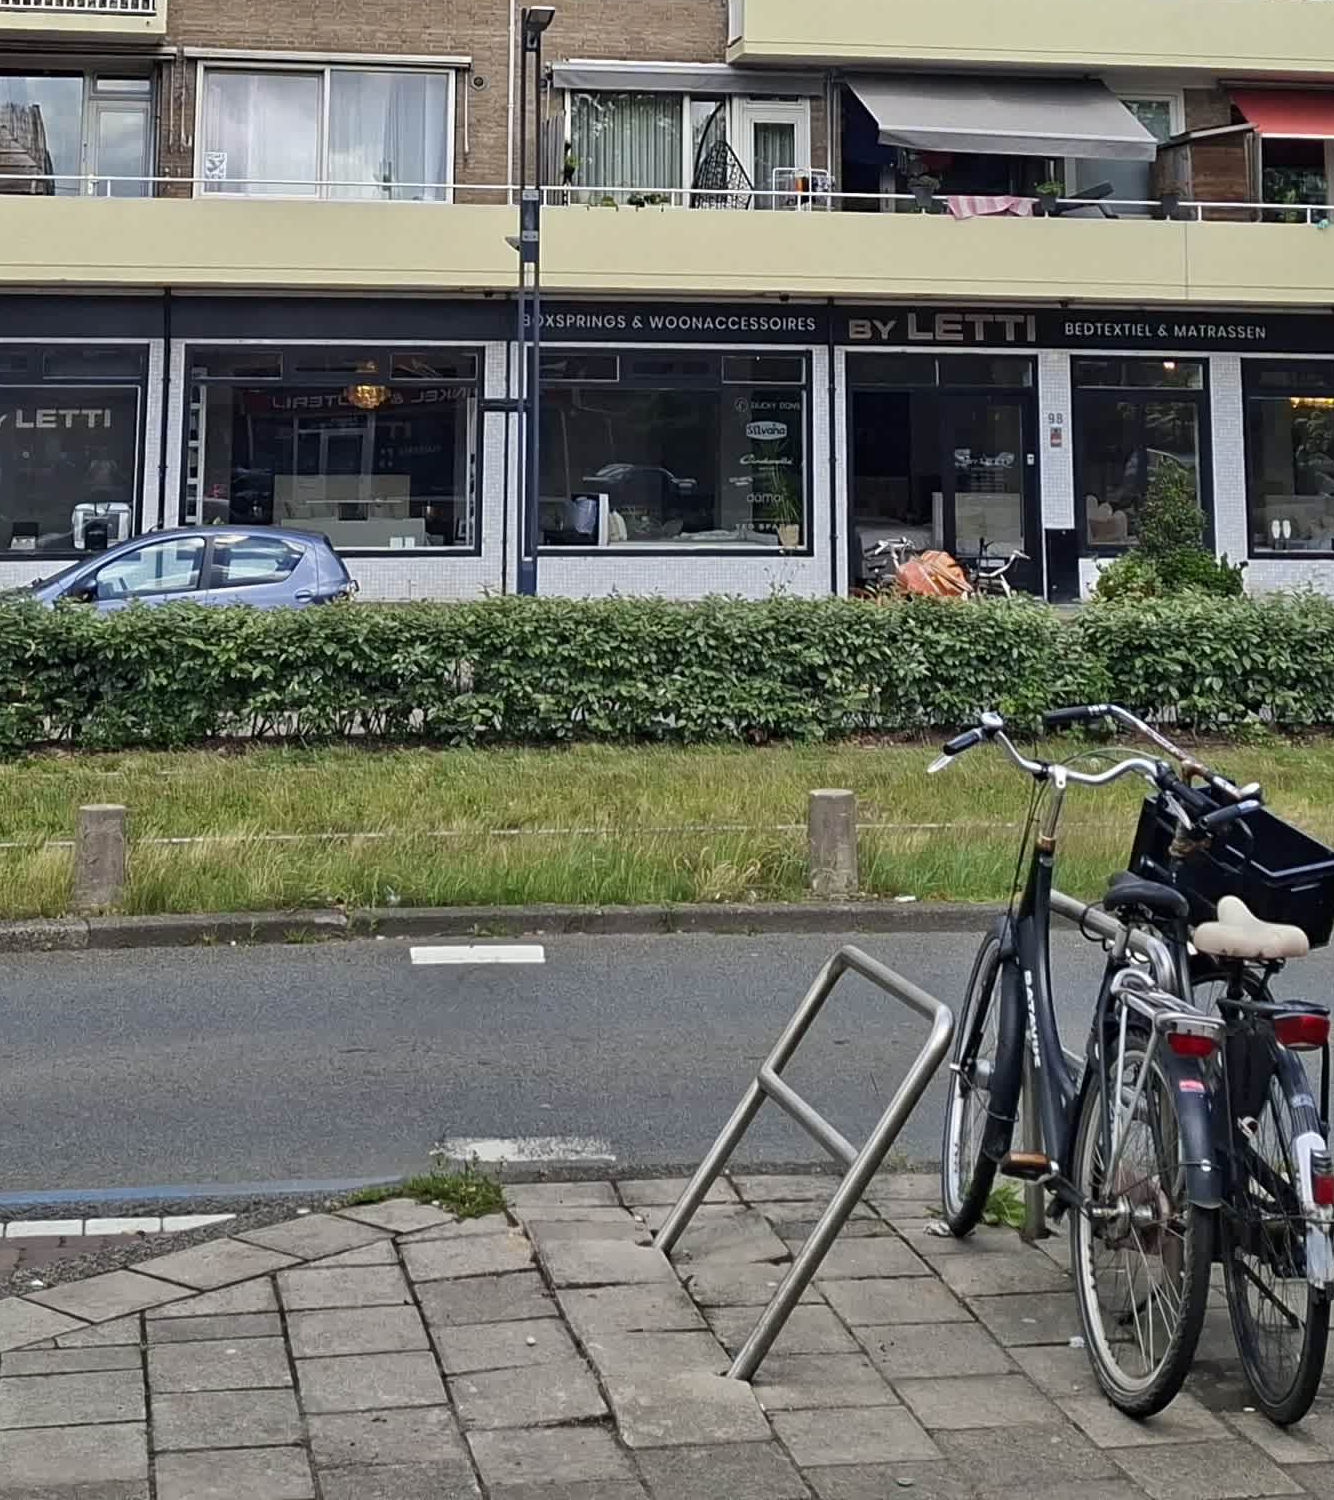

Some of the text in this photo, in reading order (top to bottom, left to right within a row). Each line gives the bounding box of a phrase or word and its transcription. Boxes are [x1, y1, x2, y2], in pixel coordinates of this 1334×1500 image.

[631, 315, 644, 329] &
[649, 315, 817, 331] WOONACCESSOIRES
[848, 312, 1036, 342] BY LETTI
[1064, 322, 1267, 339] BEDTEXTIEL & MATRASSEN
[15, 408, 112, 429] LETTI
[1048, 412, 1063, 425] 98
